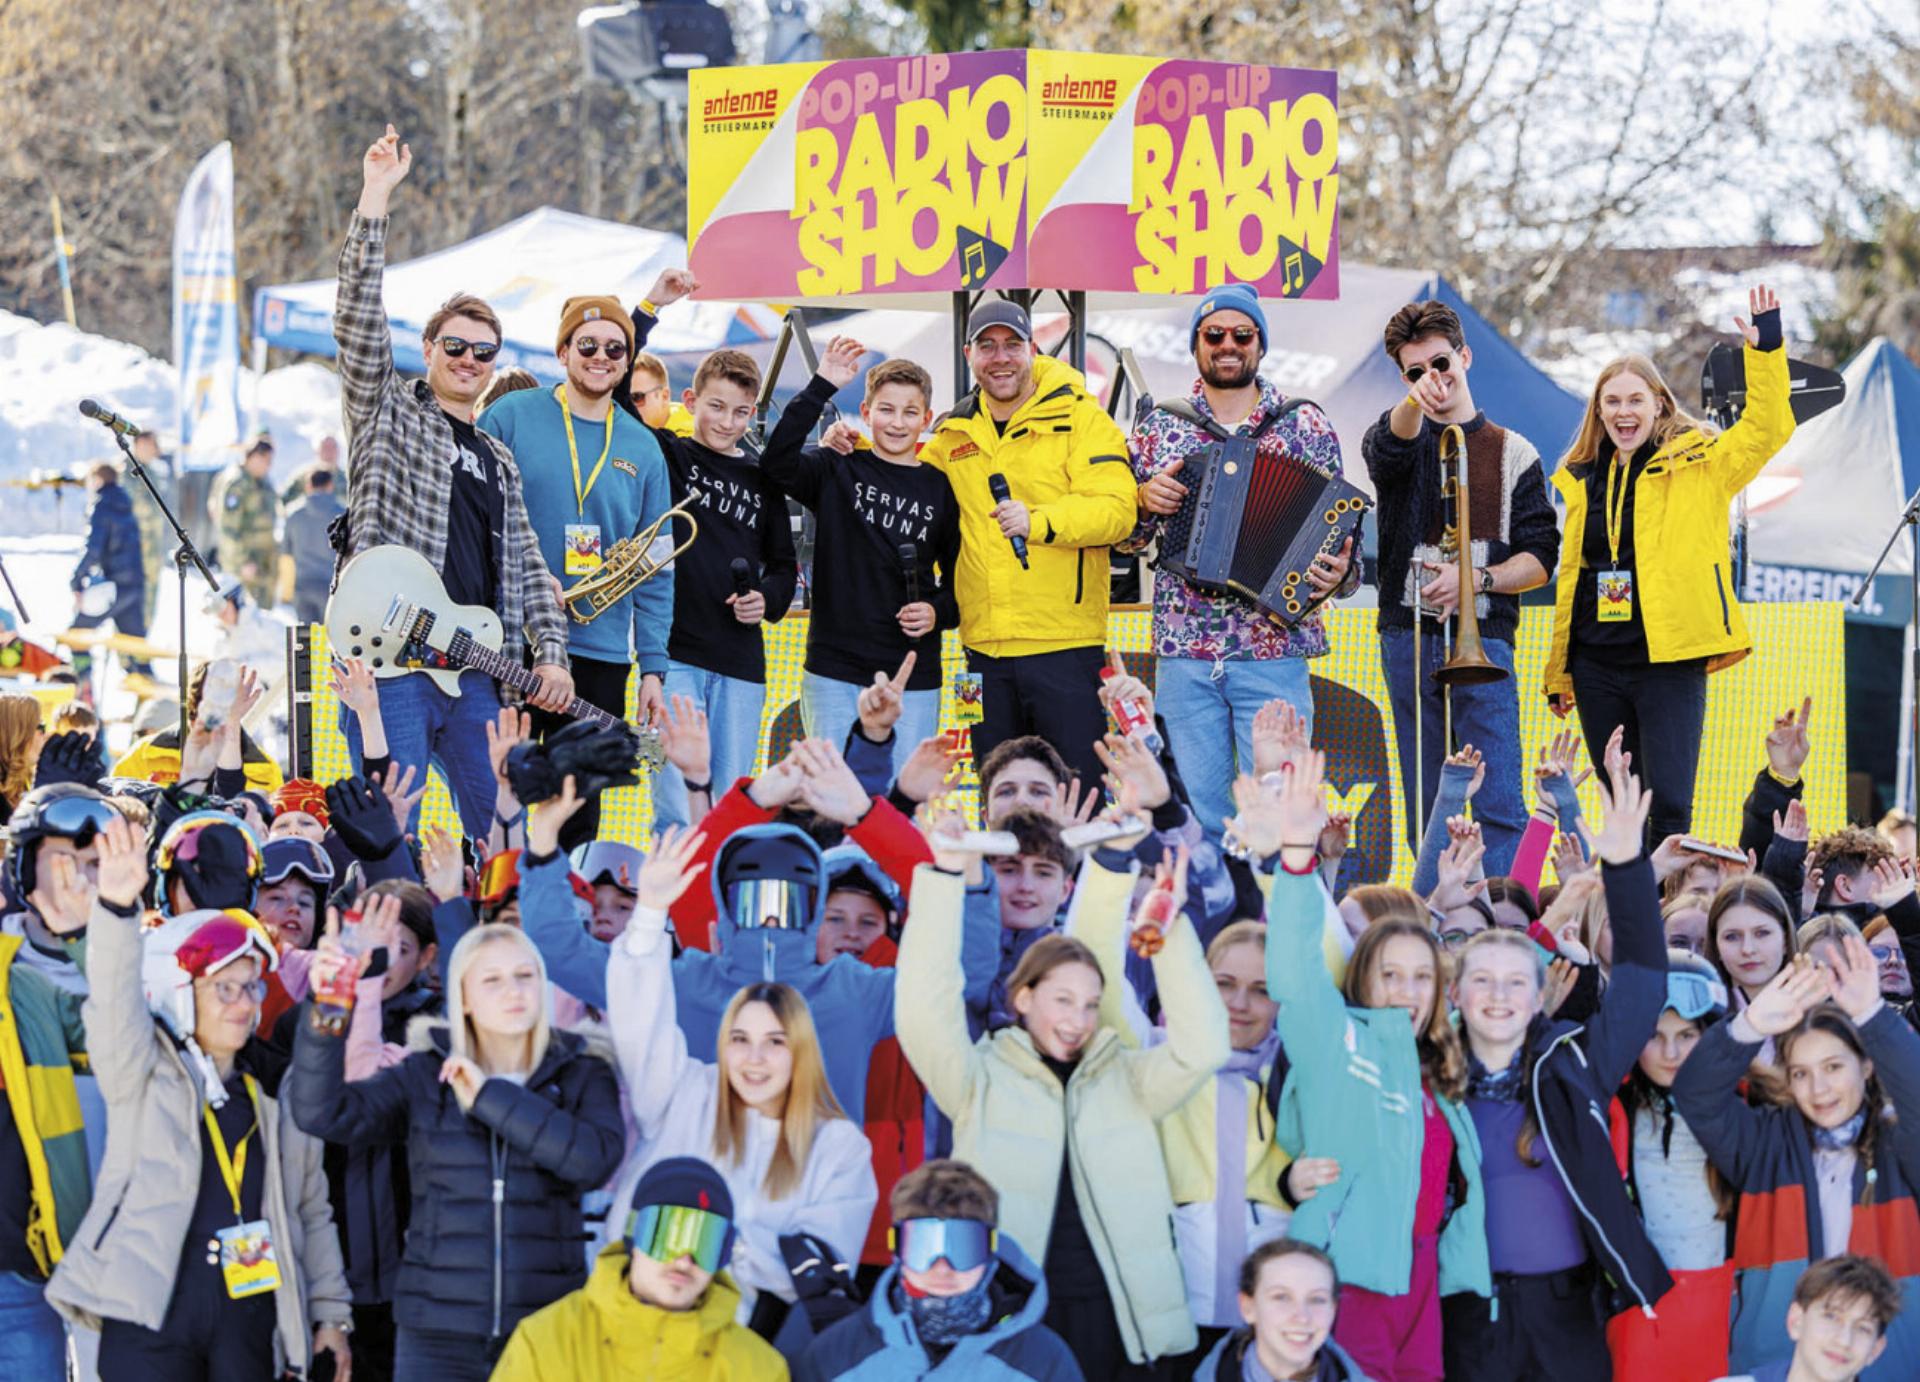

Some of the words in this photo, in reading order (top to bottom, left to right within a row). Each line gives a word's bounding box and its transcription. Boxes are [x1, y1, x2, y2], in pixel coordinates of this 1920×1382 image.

[703, 88, 778, 115] antenne
[797, 54, 950, 130] POP-UP
[1042, 73, 1117, 100] antenne
[1134, 65, 1271, 124] POP-UP
[703, 120, 775, 134] STEIERMARK
[1042, 107, 1114, 121] STEIERMARK
[790, 74, 1027, 220] RADIO
[1128, 93, 1338, 215] RADIO
[796, 156, 1027, 297] SHOW
[1132, 173, 1339, 295] SHOW
[684, 483, 757, 529] AUNA
[855, 482, 934, 521] SERVAS
